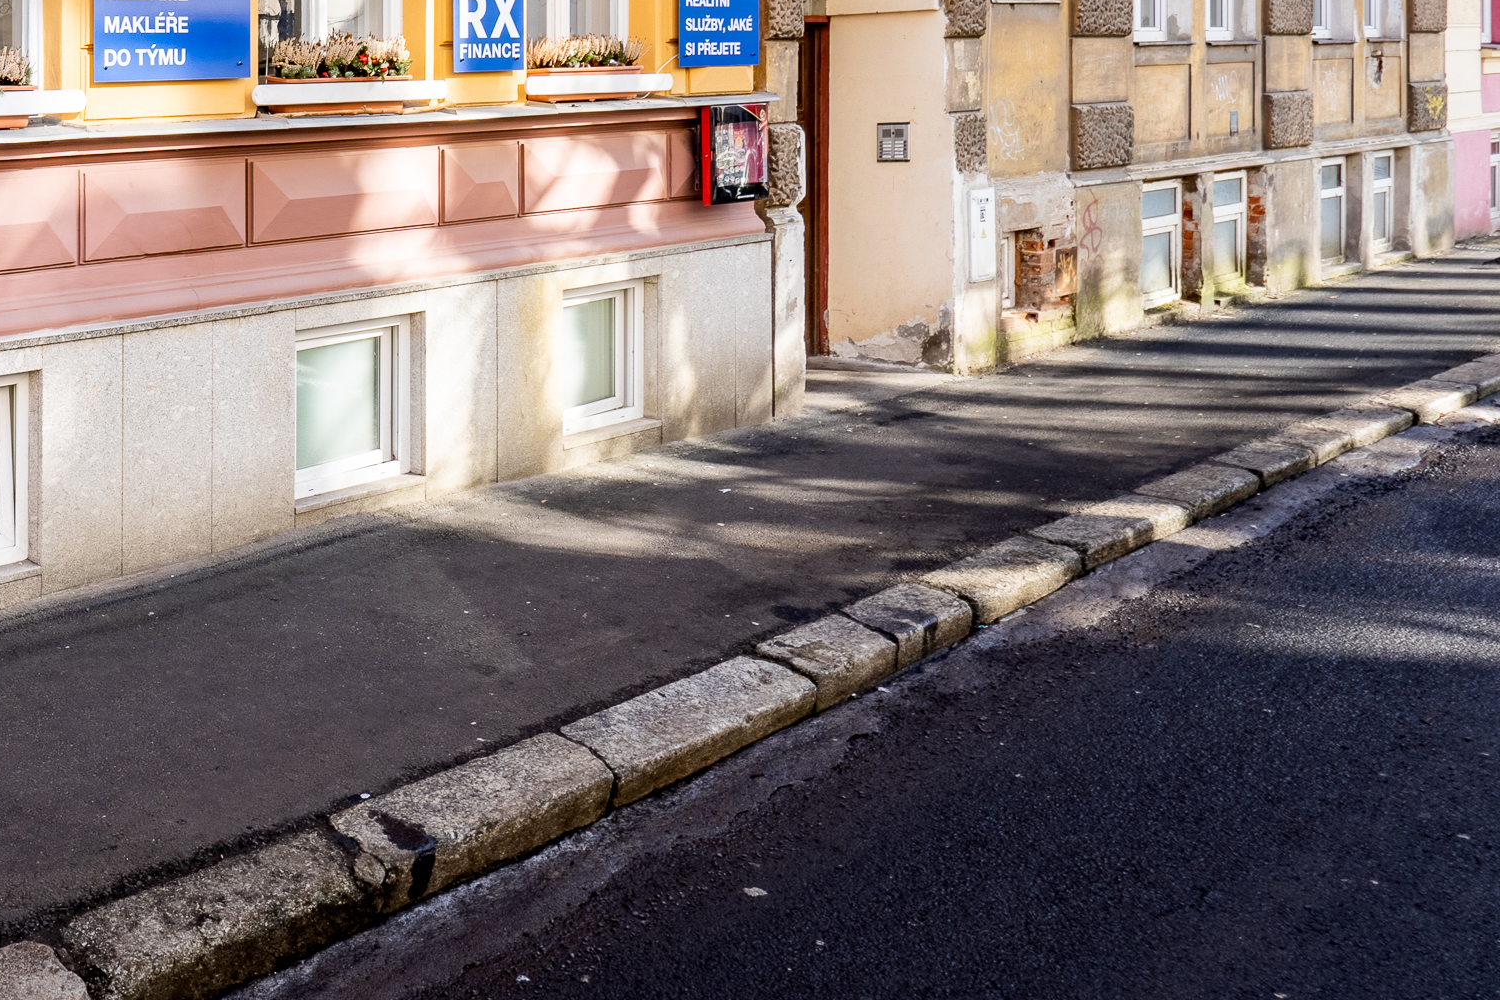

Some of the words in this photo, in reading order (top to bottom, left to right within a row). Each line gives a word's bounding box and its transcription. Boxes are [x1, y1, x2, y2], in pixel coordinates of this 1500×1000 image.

[104, 12, 189, 33] MAKLÉŘE
[685, 15, 726, 34] SLUŽBY,
[727, 15, 753, 31] JAKÉ
[104, 49, 131, 66] DO
[135, 44, 186, 66] TÝMU
[460, 43, 520, 59] FINANCE
[685, 42, 695, 56] SI
[698, 39, 741, 55] PŘEJETE
